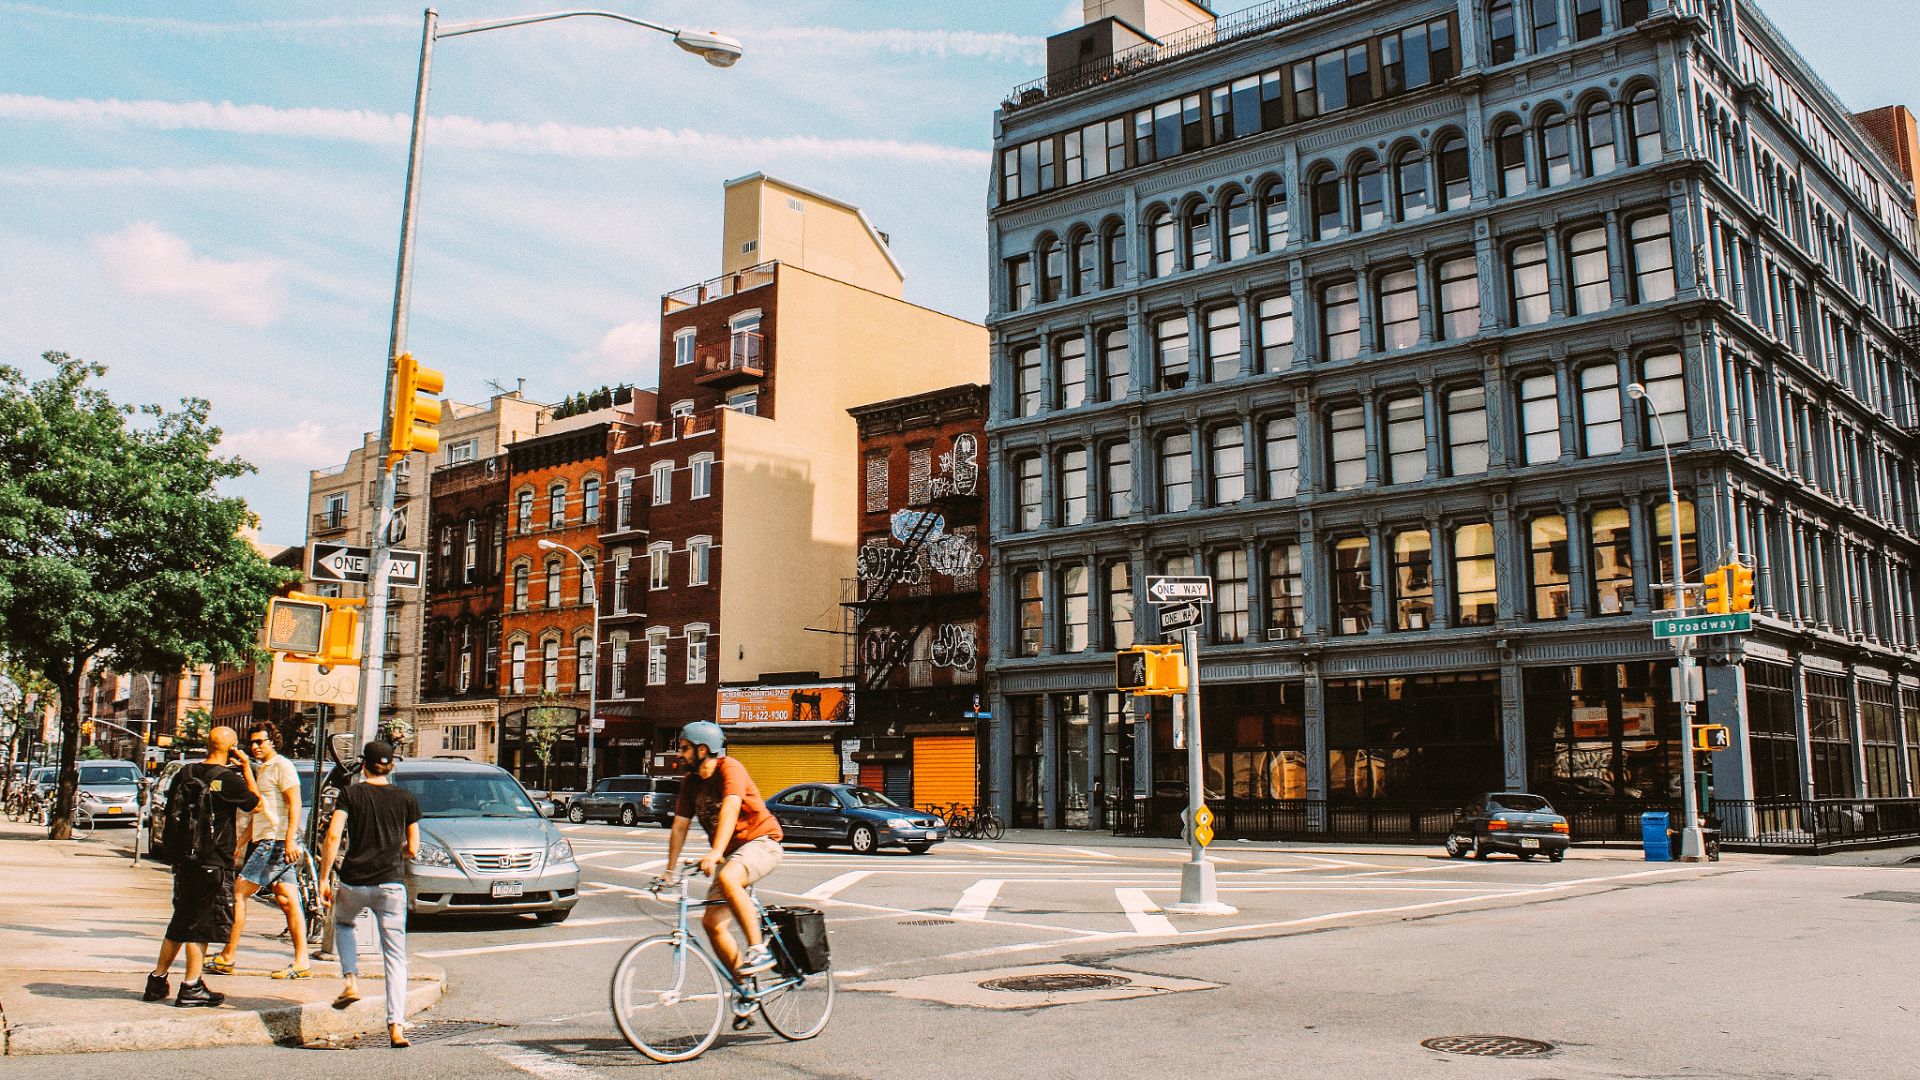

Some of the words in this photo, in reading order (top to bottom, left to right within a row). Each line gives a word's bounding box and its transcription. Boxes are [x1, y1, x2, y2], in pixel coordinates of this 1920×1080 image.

[334, 556, 363, 572] ONE
[389, 562, 409, 576] AY
[1157, 584, 1175, 595] ONE
[1183, 584, 1203, 595] WAY
[1164, 612, 1178, 624] ONE
[1182, 608, 1196, 620] WAY
[1668, 619, 1736, 633] Broadway
[740, 711, 788, 720] 718-622-9300
